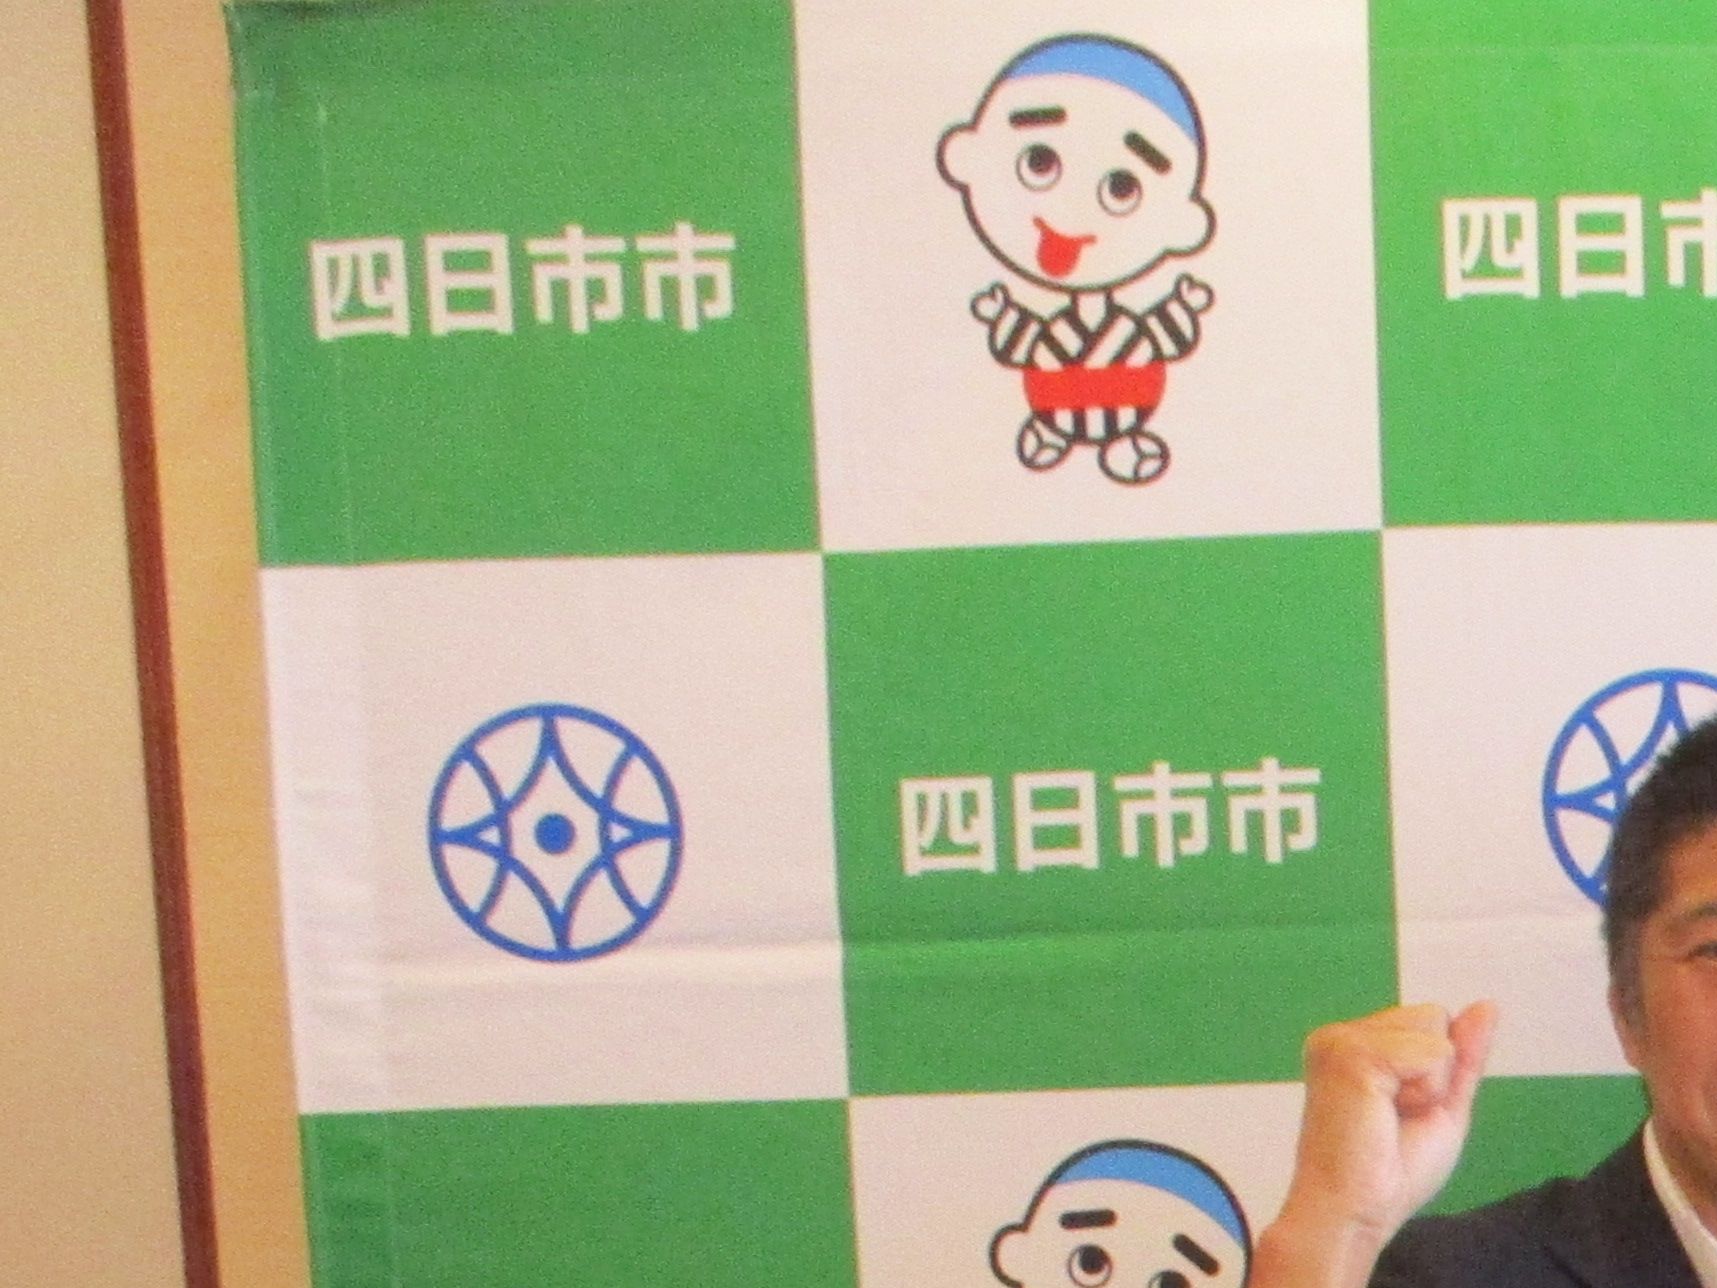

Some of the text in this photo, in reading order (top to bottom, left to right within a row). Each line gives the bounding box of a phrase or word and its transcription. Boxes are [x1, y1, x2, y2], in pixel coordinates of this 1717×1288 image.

[308, 221, 735, 341] 四日市市
[900, 757, 1321, 876] 四日市市
